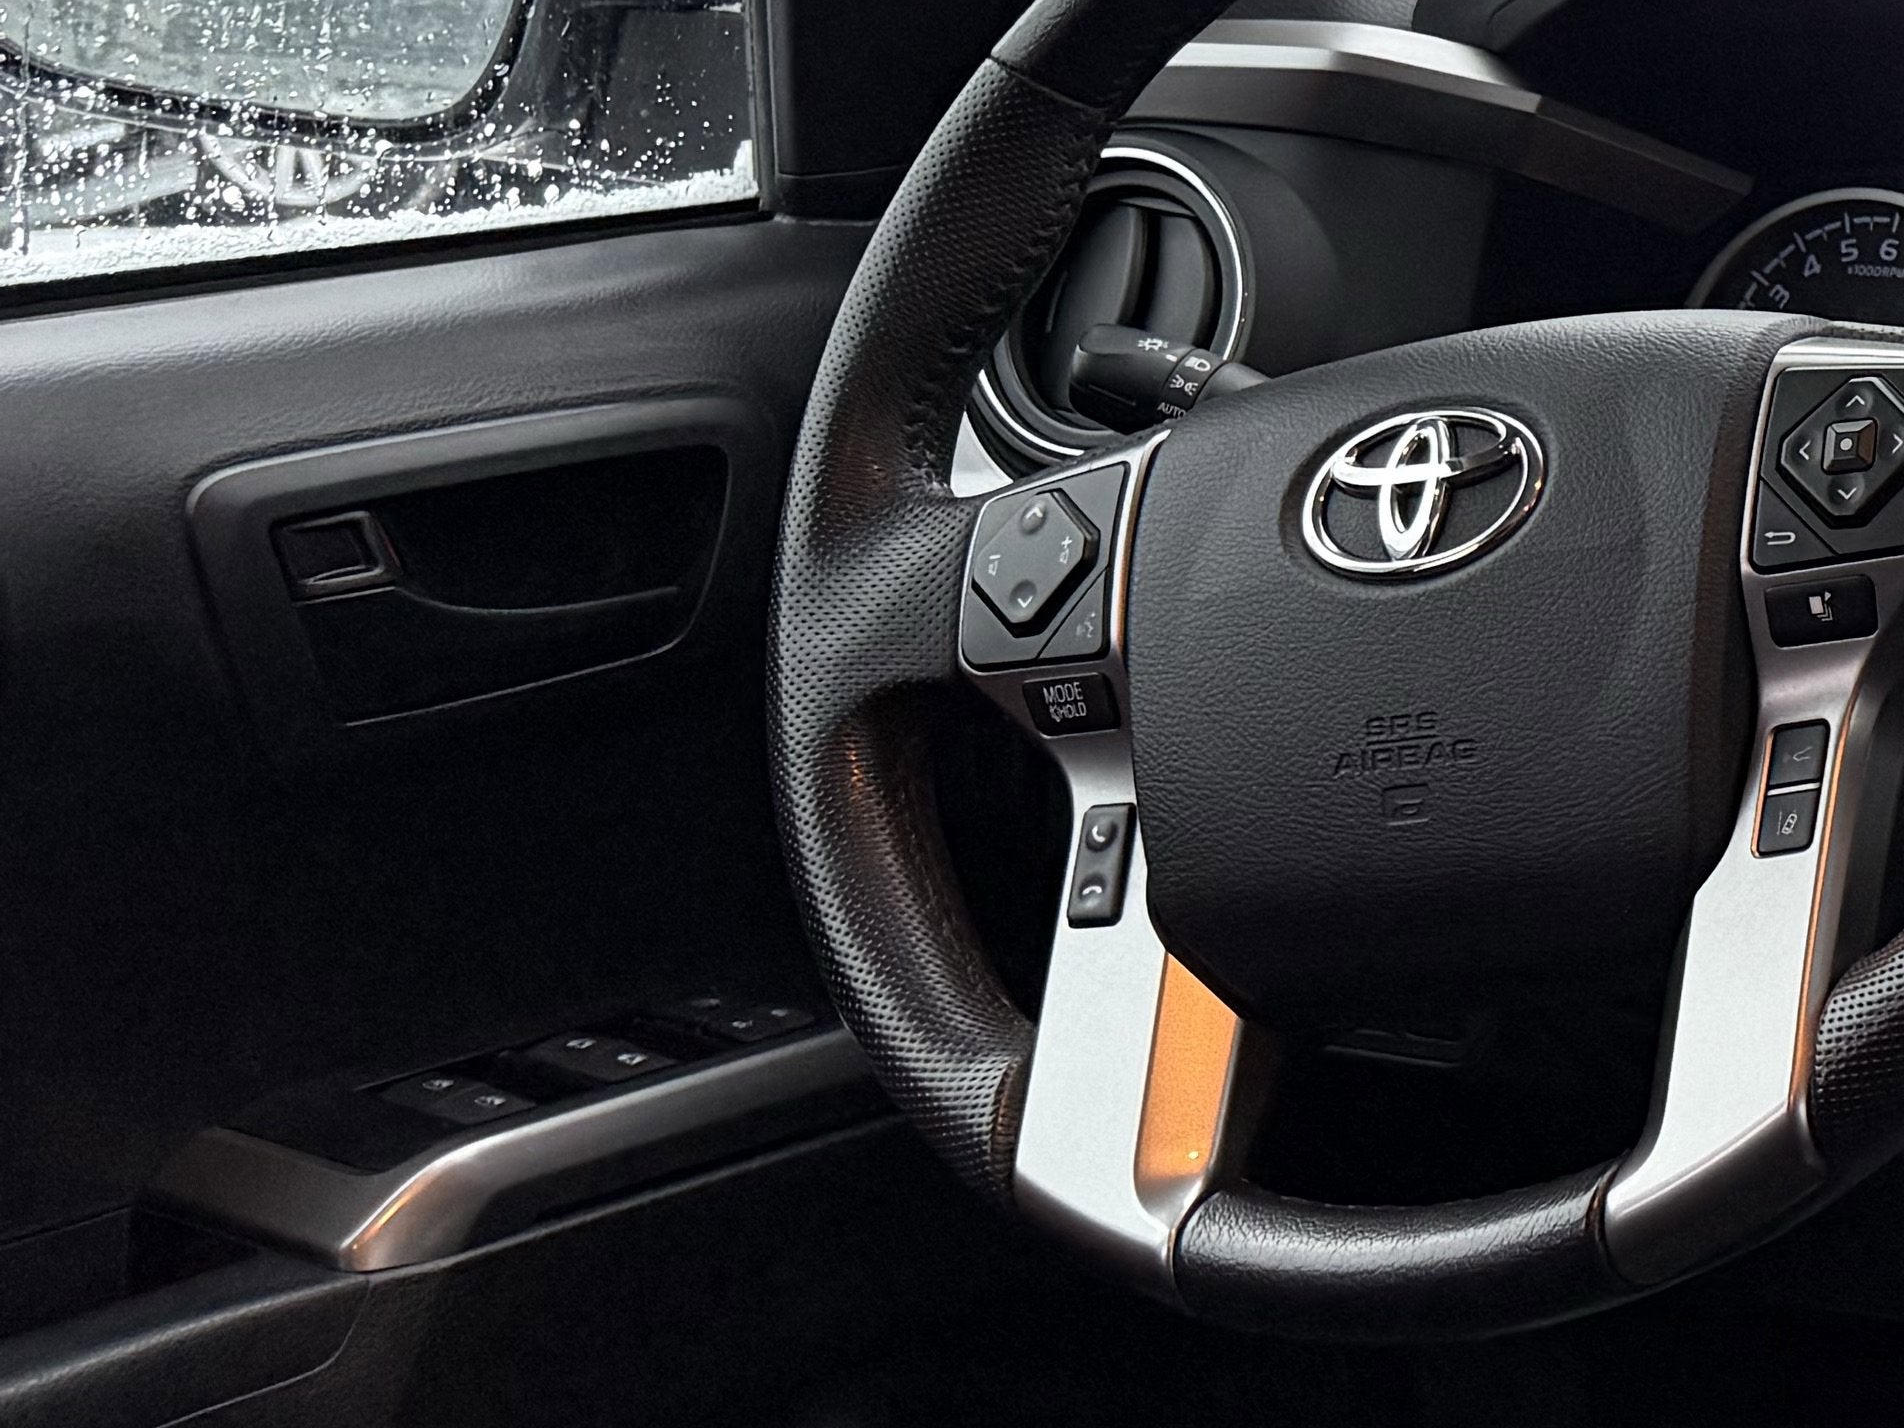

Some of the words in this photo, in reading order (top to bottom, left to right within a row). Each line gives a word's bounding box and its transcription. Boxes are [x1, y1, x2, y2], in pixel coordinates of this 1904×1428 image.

[1840, 239, 1859, 262] 5
[1879, 239, 1900, 262] 6
[1803, 254, 1822, 278] 4
[1768, 283, 1791, 310] 3
[1157, 401, 1188, 420] AUTO
[1042, 681, 1085, 705] MODE
[1365, 710, 1439, 736] SRS
[1332, 738, 1479, 779] AIRBAG
